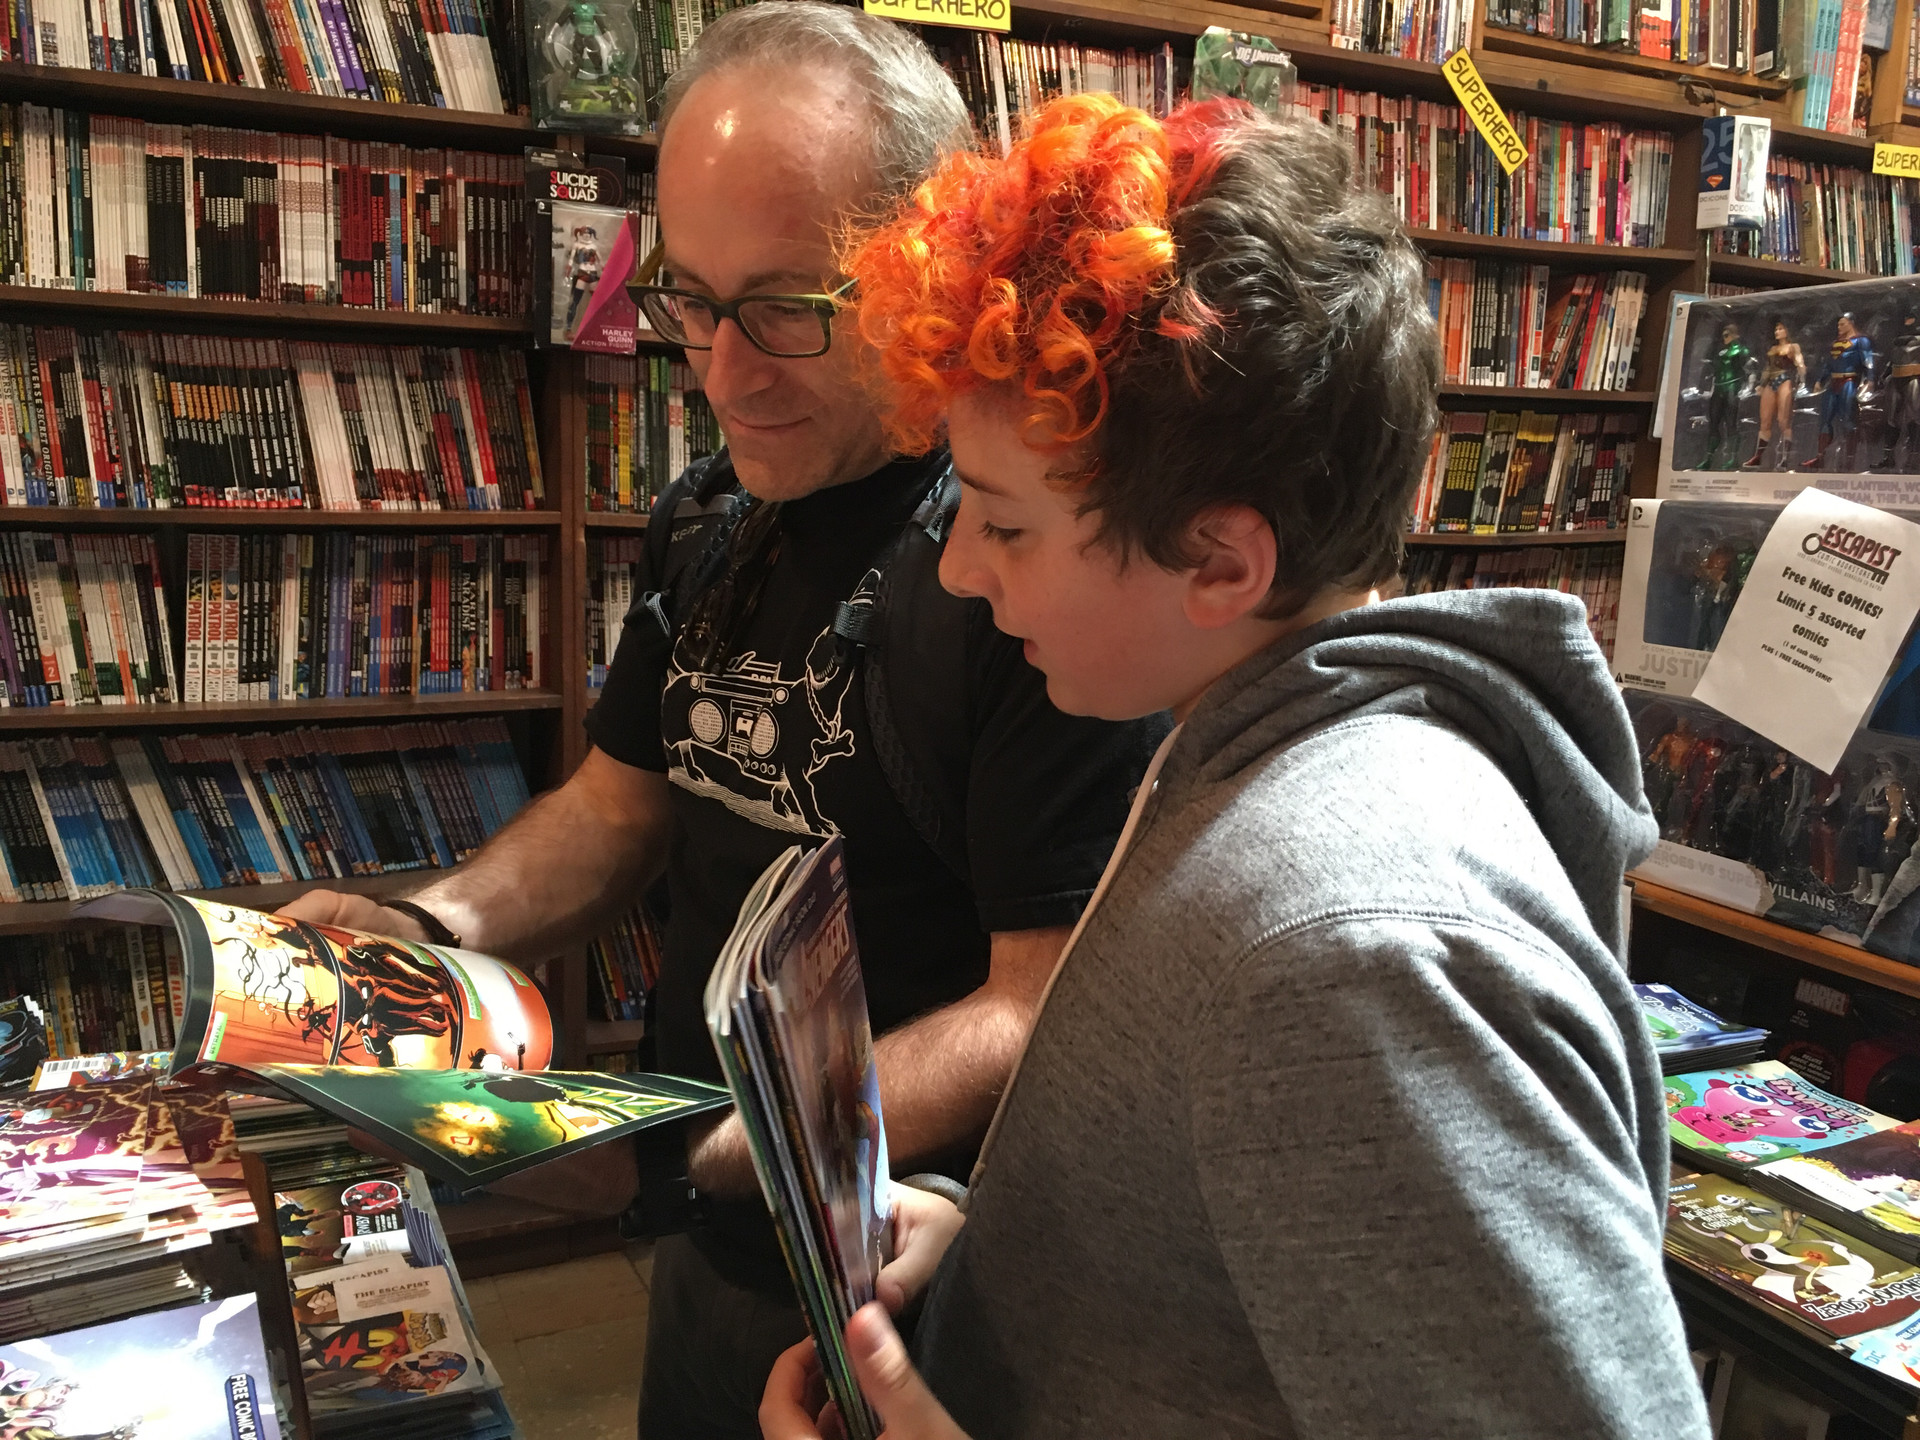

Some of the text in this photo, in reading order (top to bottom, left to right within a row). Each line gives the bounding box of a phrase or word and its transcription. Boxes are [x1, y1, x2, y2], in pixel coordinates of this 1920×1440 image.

[690, 1, 700, 21] GREEN
[868, 0, 1005, 19] ERHERO
[649, 10, 657, 39] LANTERN
[680, 19, 690, 48] LANTERN
[327, 20, 346, 68] BY JACK KIRBY
[340, 22, 359, 70] BY JACK KIRBY
[1236, 47, 1252, 61] DC
[1450, 56, 1523, 164] SUPERHERO
[1700, 119, 1735, 173] 25
[1876, 151, 1920, 170] SUPER
[146, 163, 154, 202] DAREDEVIL
[155, 165, 163, 205] DAREDEVIL
[549, 184, 597, 202] SQUAD
[550, 170, 598, 189] SUICIDE
[602, 329, 633, 338] HARLEY
[607, 336, 633, 344] QUINN
[1618, 378, 1628, 388] 2
[7, 403, 16, 436] LEGACIES
[37, 408, 48, 444] SECRET
[42, 447, 54, 487] ORIGINS
[1816, 479, 1850, 490] GREEN
[1877, 494, 1920, 506] THE FLA
[190, 537, 203, 569] DOOM
[1822, 523, 1902, 571] ESCAPIST
[1817, 551, 1872, 579] COMIC BOOKSTORE
[504, 577, 512, 605] ELEKTRA
[1782, 566, 1807, 585] Free
[1809, 578, 1835, 598] Kids
[461, 573, 470, 632] PARADISE
[469, 581, 477, 631] EARTH
[1777, 590, 1866, 640] Limit 5 assorted
[40, 626, 48, 641] ATOM
[189, 602, 202, 642] PATROL
[208, 602, 221, 643] PATROL
[1792, 624, 1829, 647] comics
[225, 602, 238, 676] PATROL 3
[48, 667, 55, 677] 2
[1761, 644, 1774, 654] PLUS
[1779, 652, 1791, 663] FREE
[1792, 659, 1815, 674] ESCAPIST
[1653, 849, 1694, 869] EROES
[1699, 863, 1715, 876] VS
[148, 966, 166, 1004] FLASH
[172, 980, 183, 1017] FLASH
[1766, 1078, 1868, 1124] INVADER
[1858, 1109, 1874, 1117] DAY
[356, 1215, 371, 1235] RWBY
[339, 1267, 390, 1282] ESCAPIST
[353, 1281, 430, 1299] THE ESCAPIST
[231, 1374, 255, 1429] FREE COMIC
